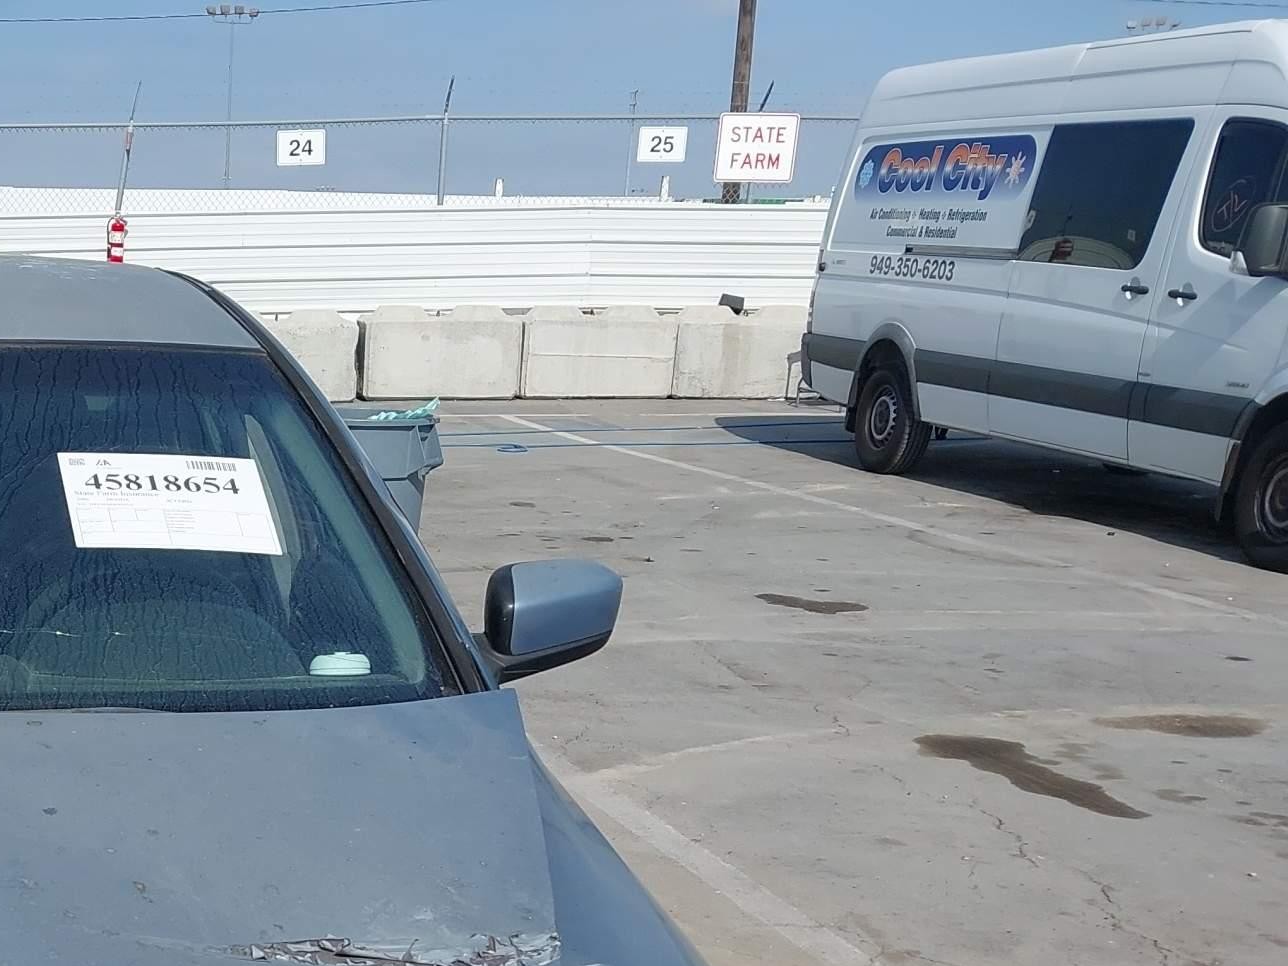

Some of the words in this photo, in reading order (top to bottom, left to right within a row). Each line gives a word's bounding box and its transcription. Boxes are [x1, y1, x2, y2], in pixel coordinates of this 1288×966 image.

[731, 126, 786, 143] STATE
[289, 139, 313, 157] 24
[650, 135, 674, 153] 25
[730, 152, 780, 170] FARM
[878, 147, 944, 195] Cool
[942, 142, 1008, 200] City
[870, 208, 879, 220] Air
[878, 208, 912, 222] Conditioning
[919, 208, 941, 223] Heating
[947, 208, 988, 223] Refrigeration
[886, 225, 918, 237] Commercial
[918, 226, 924, 237] &
[924, 226, 958, 239] Residential
[869, 255, 955, 282] 949-350-6203
[84, 472, 240, 495] 45818654
